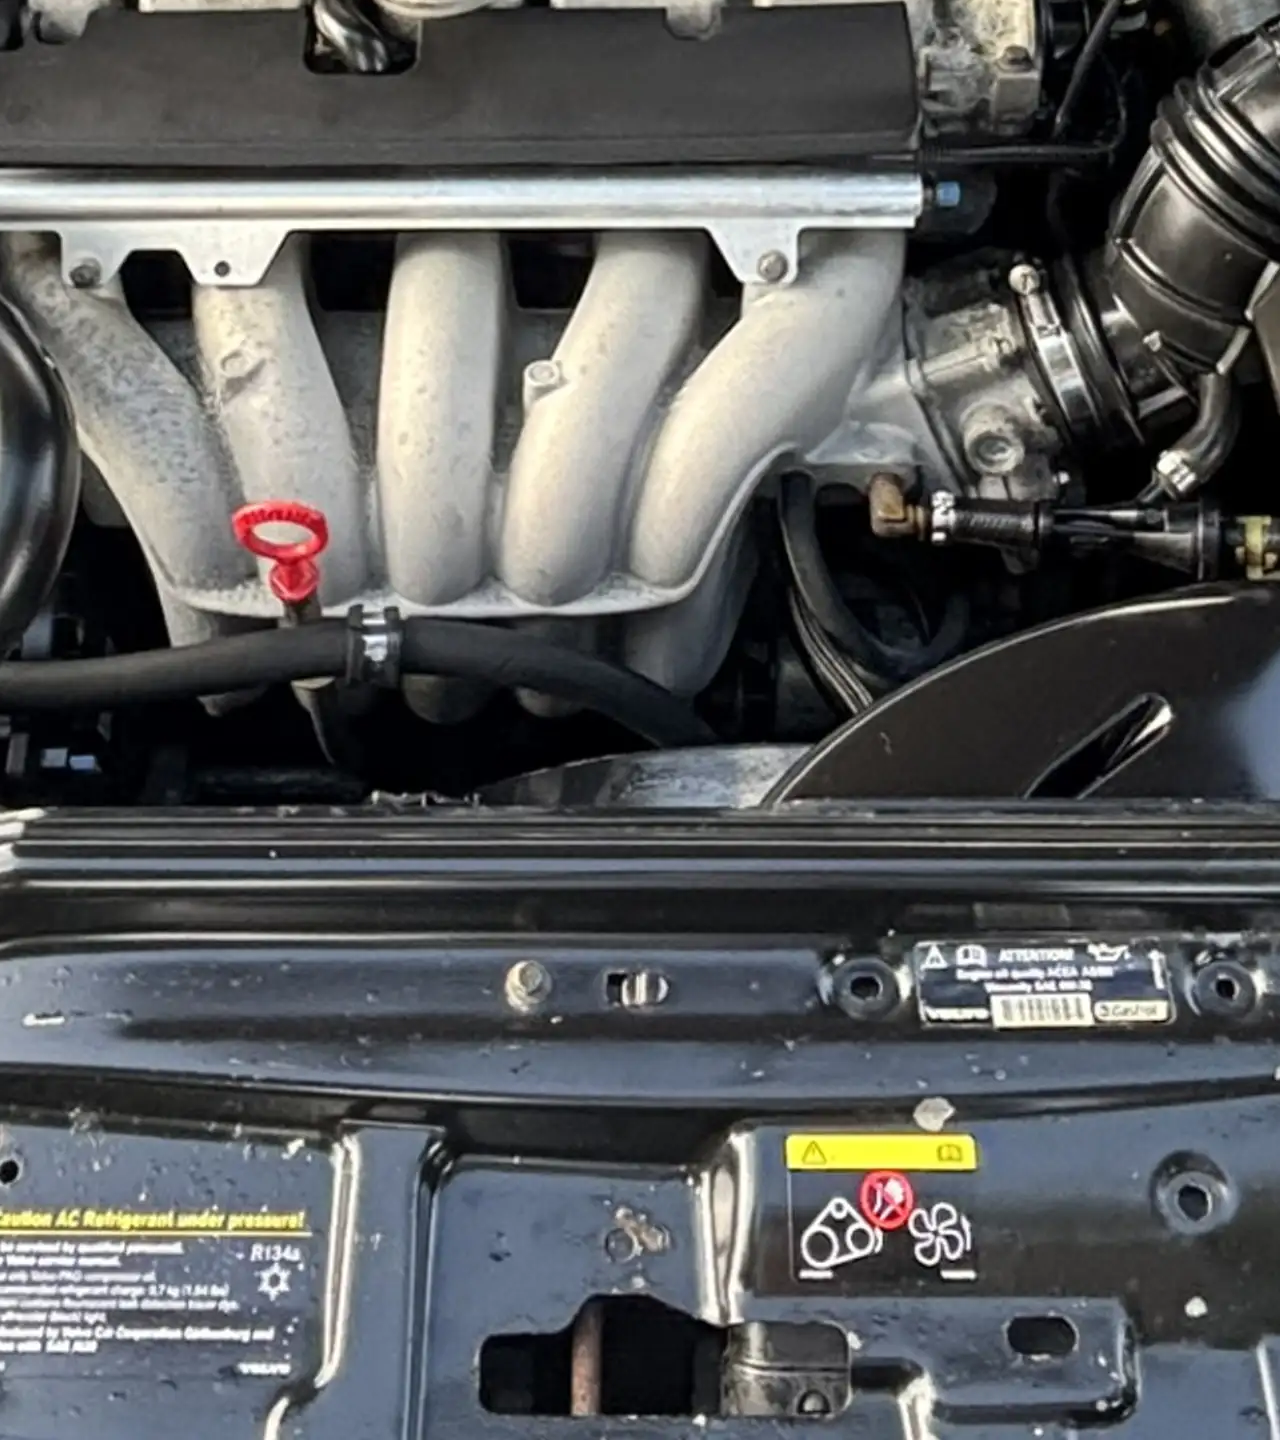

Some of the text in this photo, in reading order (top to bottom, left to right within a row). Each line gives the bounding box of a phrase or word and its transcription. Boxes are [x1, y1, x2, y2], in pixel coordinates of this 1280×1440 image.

[55, 1208, 81, 1227] AC
[83, 1208, 174, 1231] Refrigerant
[176, 1210, 225, 1228] under
[226, 1211, 306, 1231] pressure!
[250, 1243, 301, 1262] R134a
